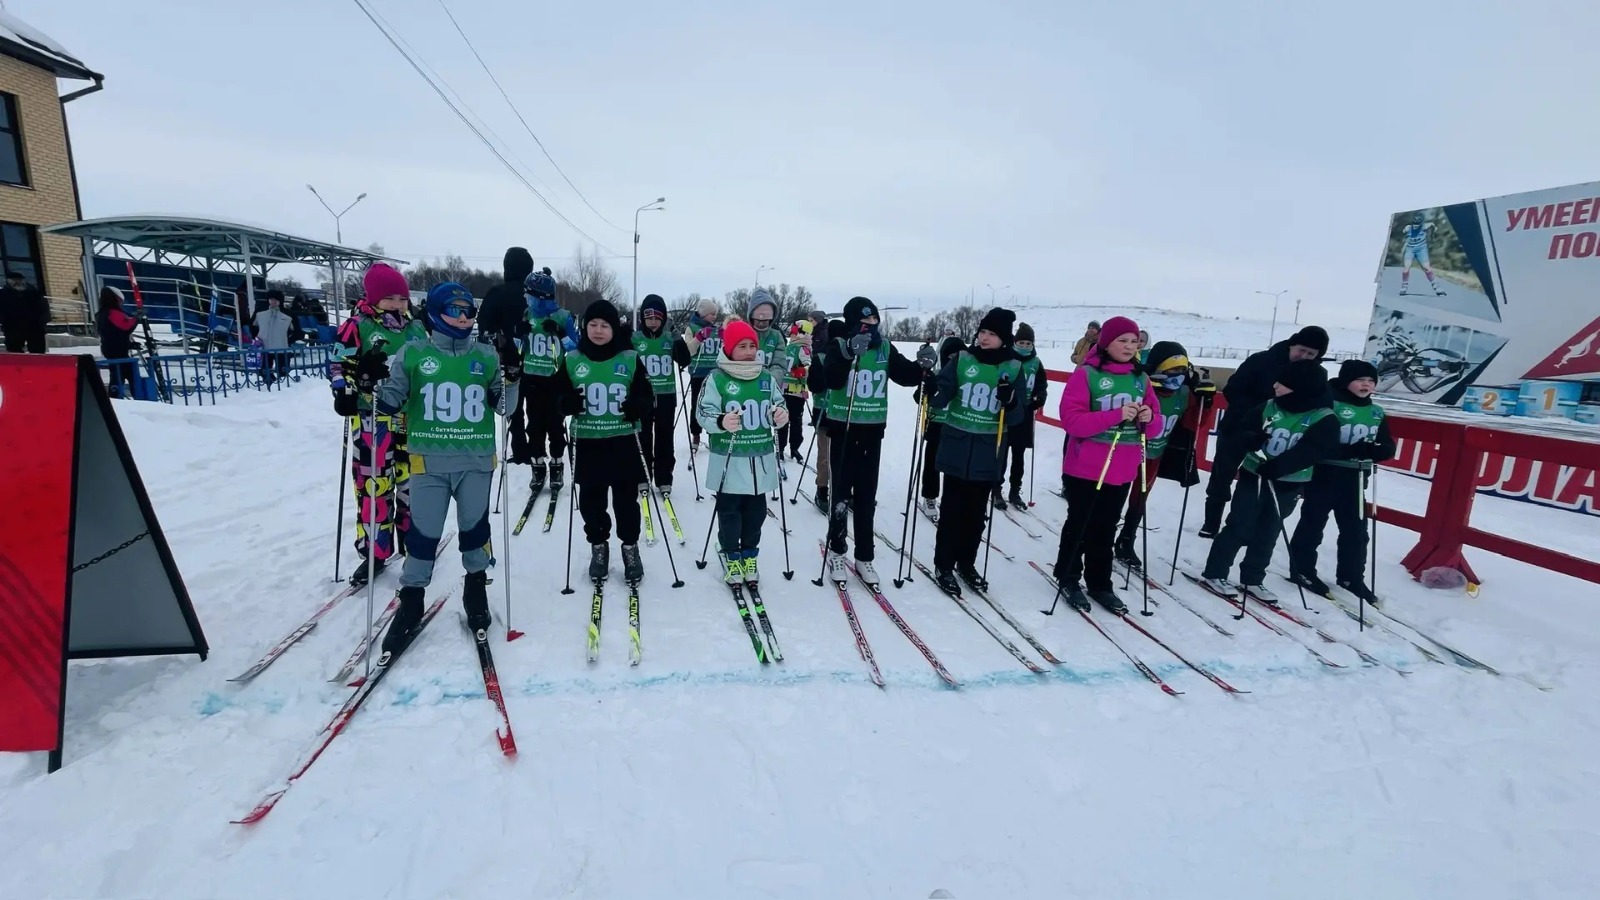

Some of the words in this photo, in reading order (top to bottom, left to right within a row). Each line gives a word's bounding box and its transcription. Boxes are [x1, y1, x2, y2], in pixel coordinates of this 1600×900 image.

[1548, 231, 1600, 260] ПО
[419, 381, 486, 423] 198
[1481, 391, 1498, 411] 2
[1542, 387, 1557, 411] 1
[411, 432, 448, 440] РЕСПУБЛИКА
[592, 595, 602, 620] ACTIVE
[630, 597, 639, 622] ACTIV
